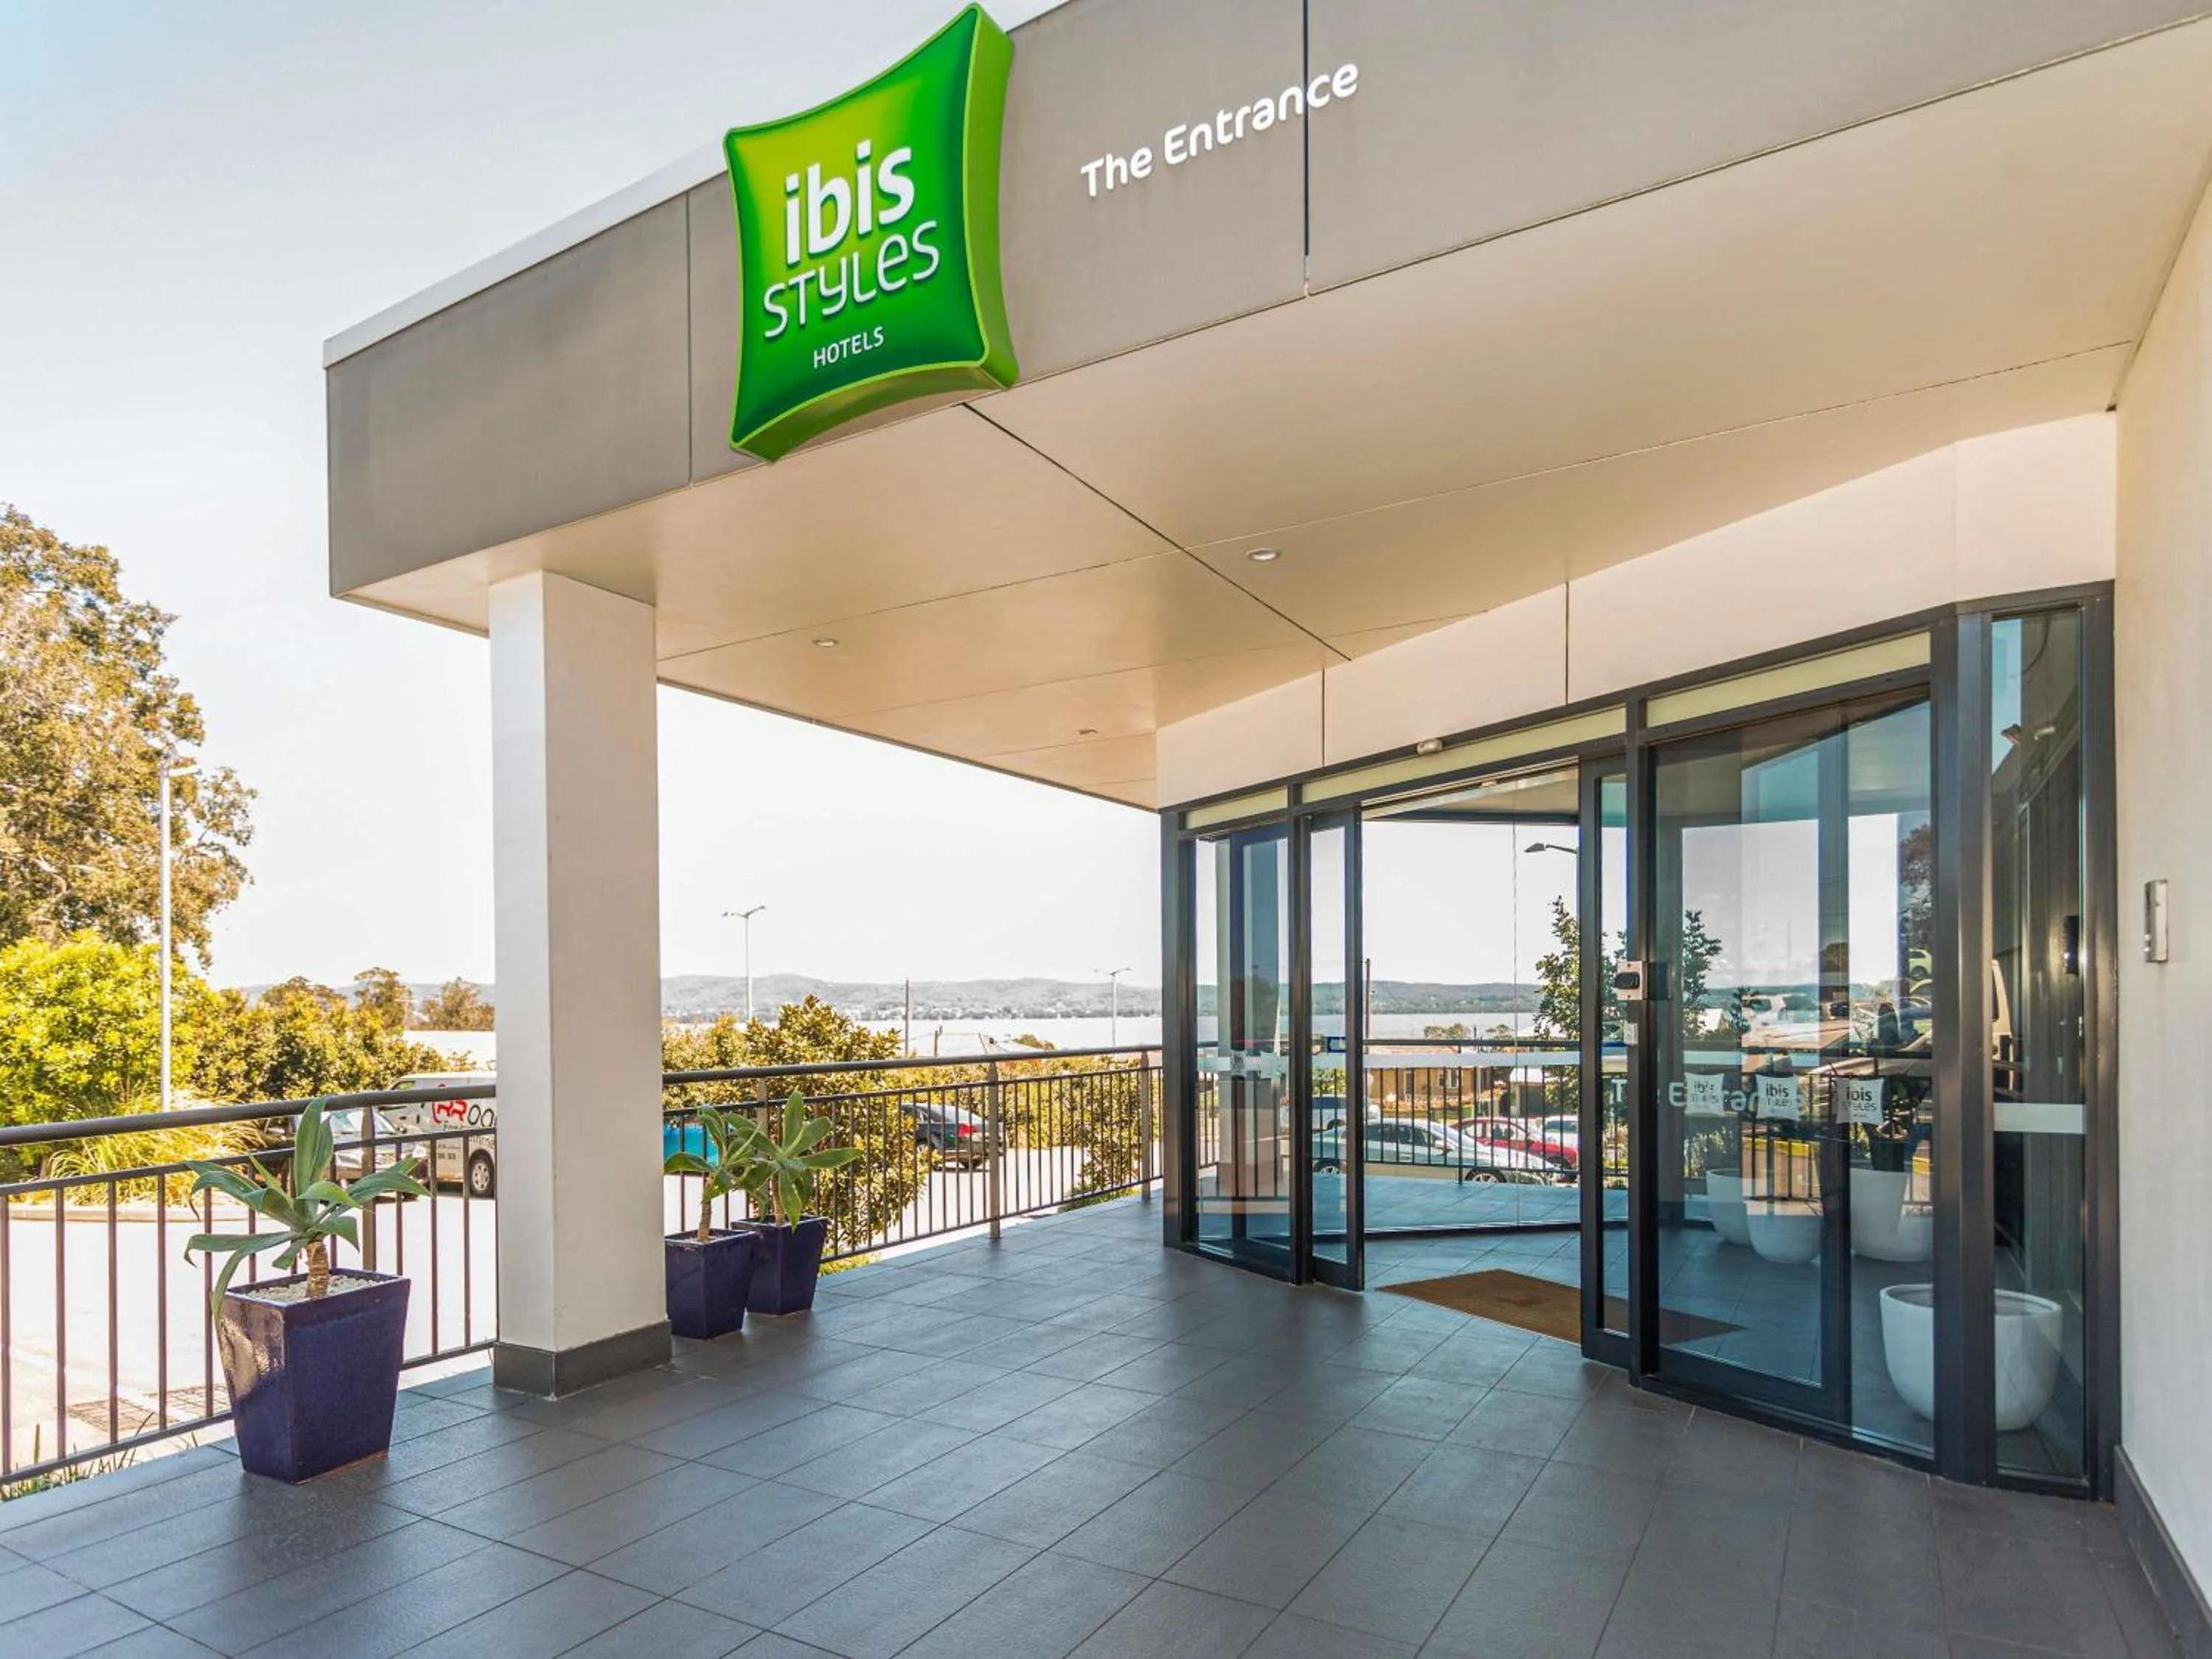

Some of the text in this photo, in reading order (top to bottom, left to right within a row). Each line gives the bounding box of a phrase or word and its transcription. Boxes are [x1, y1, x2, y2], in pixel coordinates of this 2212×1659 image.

[1081, 63, 1358, 197] The Entrance
[785, 139, 915, 265] ibis
[813, 326, 884, 369] HOTELS
[1766, 1083, 1790, 1097] ibis
[1846, 1086, 1873, 1102] ibis
